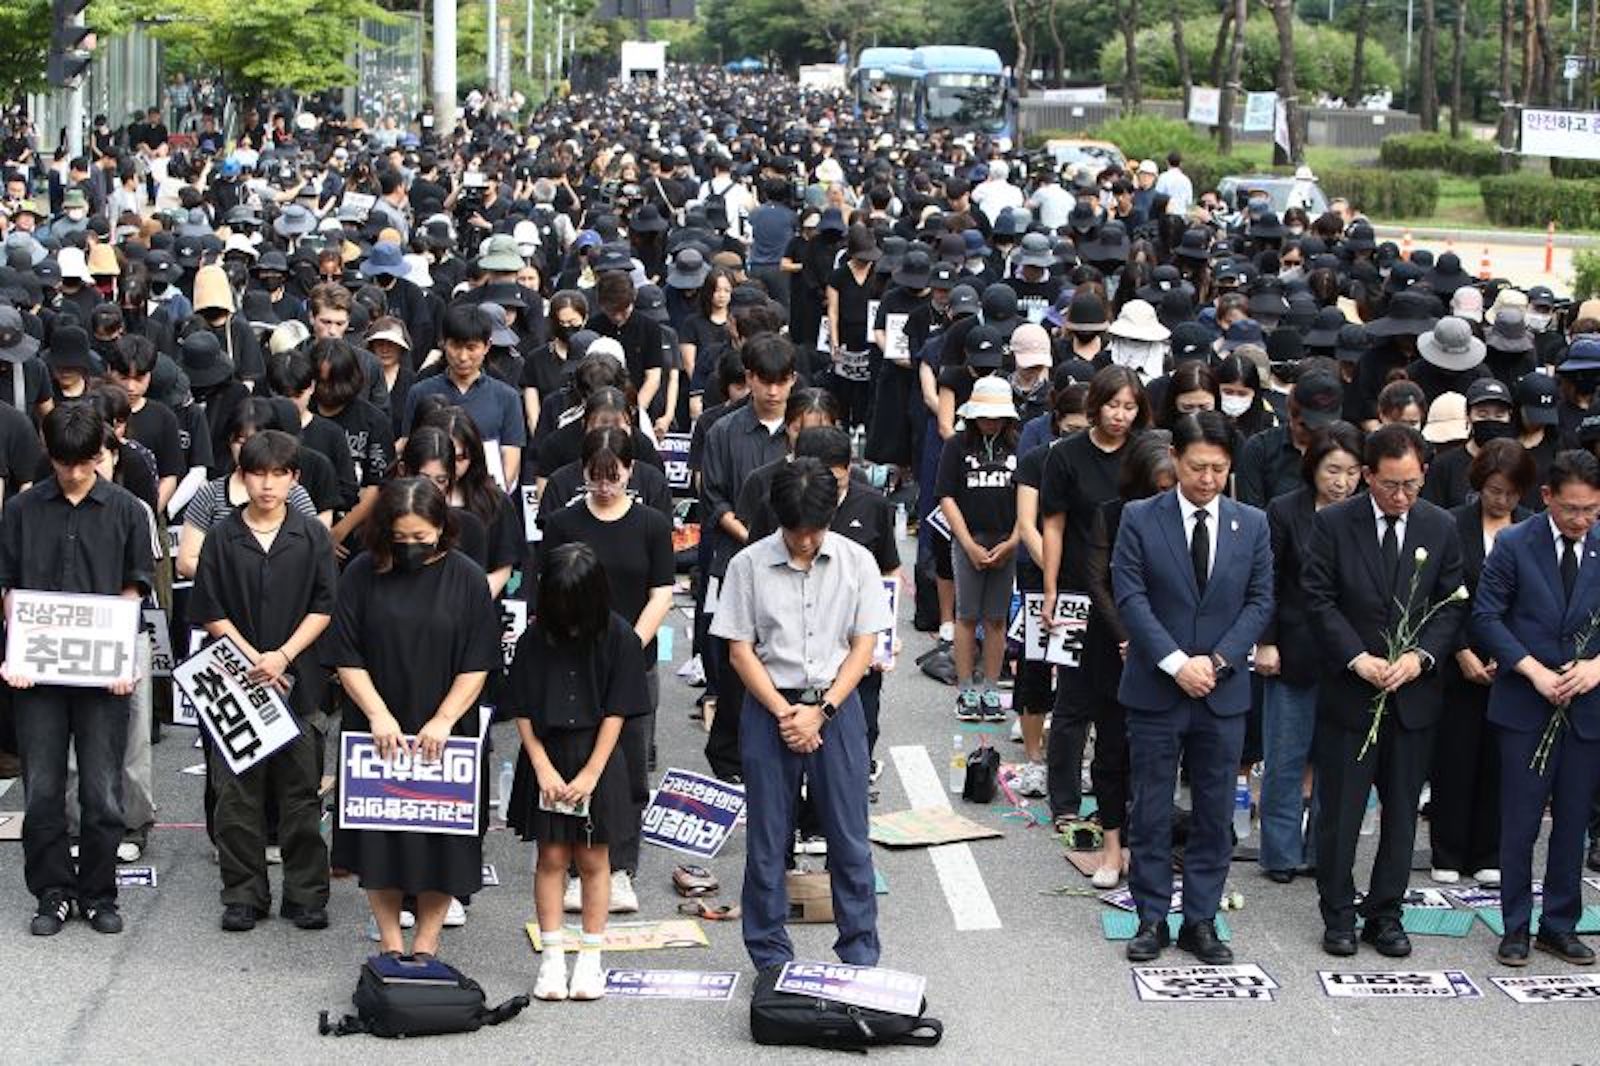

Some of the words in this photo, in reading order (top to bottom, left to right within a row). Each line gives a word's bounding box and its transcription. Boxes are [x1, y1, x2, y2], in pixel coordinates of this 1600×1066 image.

[1527, 113, 1588, 132] 안전하고
[16, 601, 113, 629] 진상규명이
[24, 634, 128, 676] 추모다
[212, 642, 282, 726] 진상규명이
[192, 666, 262, 760] 추모다
[345, 797, 474, 823] 교권보호합의안
[641, 805, 726, 848] 의결하라
